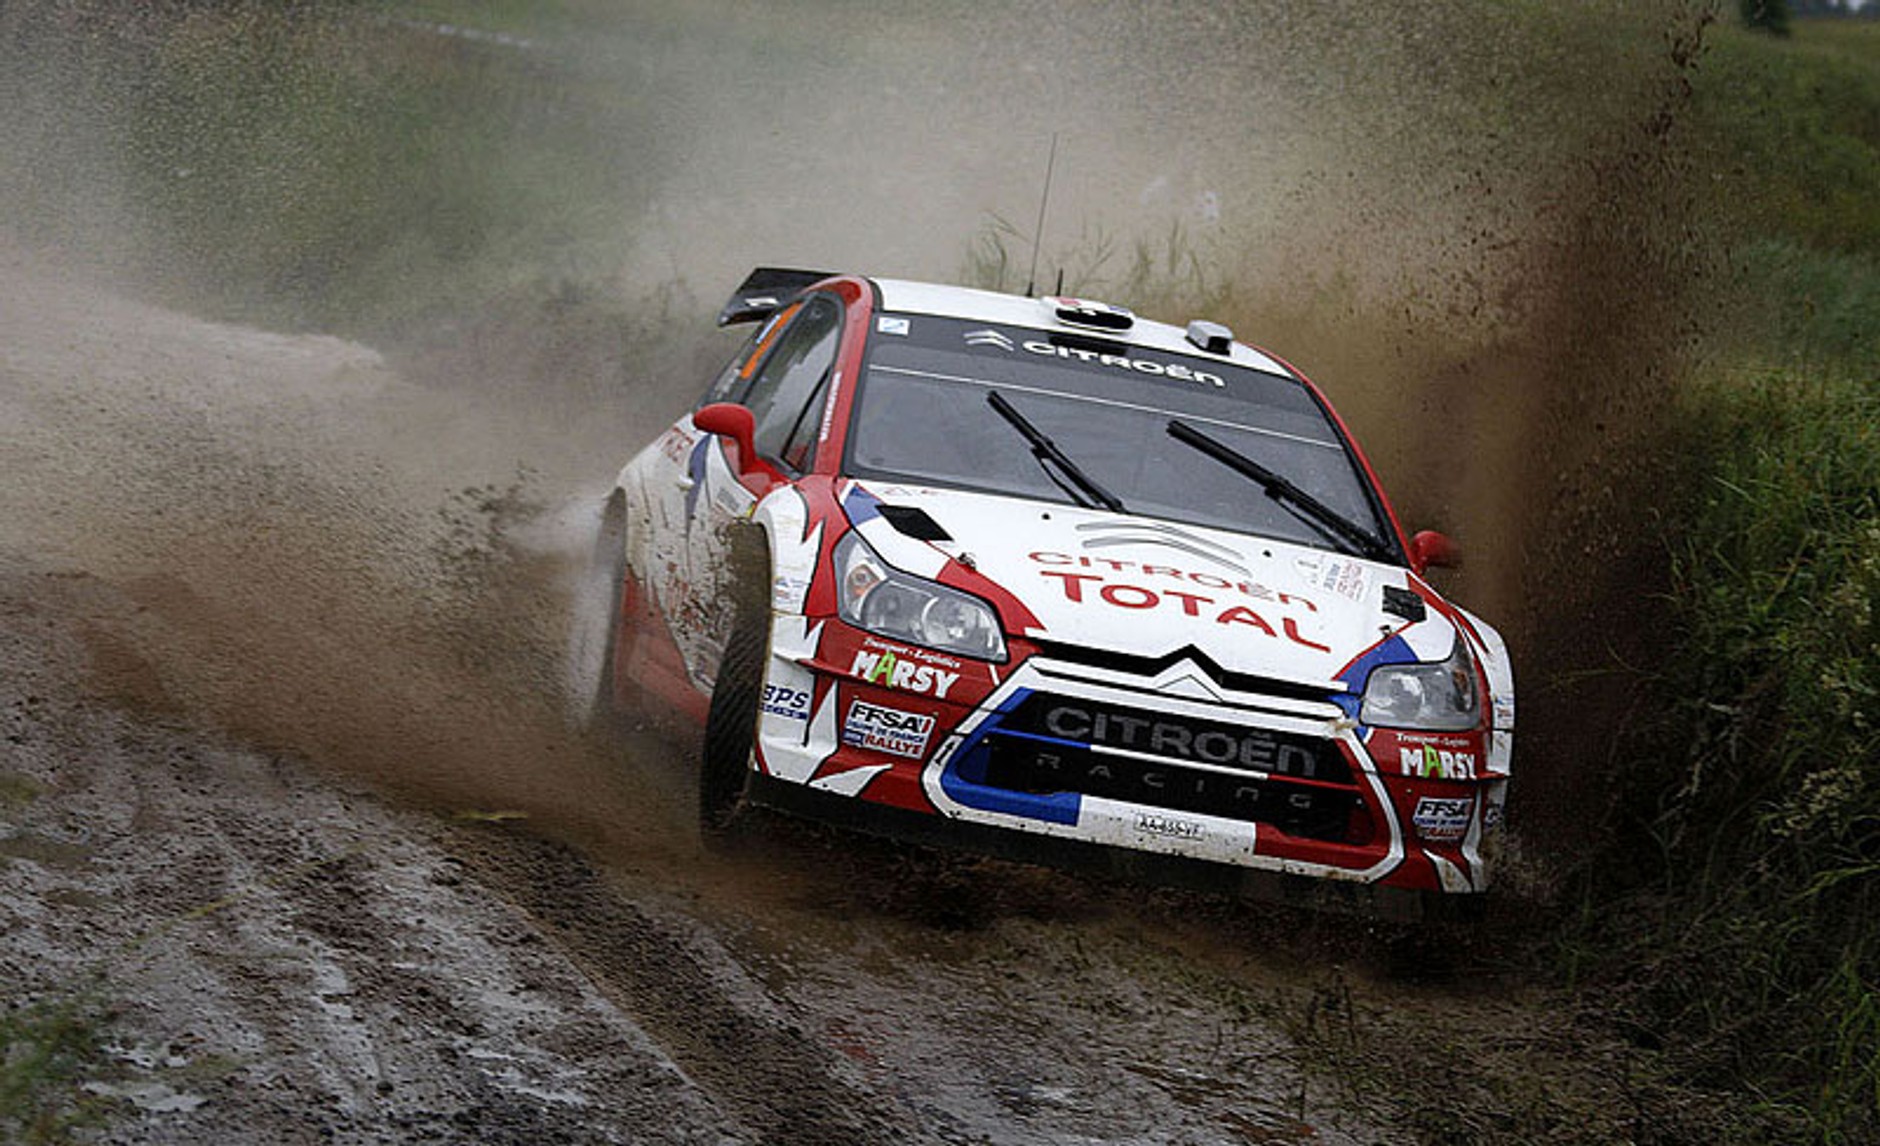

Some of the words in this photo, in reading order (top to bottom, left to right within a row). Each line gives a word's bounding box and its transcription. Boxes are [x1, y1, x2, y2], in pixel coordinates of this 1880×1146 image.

[1040, 570, 1331, 654] TOTAL
[849, 650, 960, 698] MARSY
[851, 704, 921, 734] FFSA
[864, 734, 922, 755] RALLYE
[1400, 744, 1477, 779] MARSY
